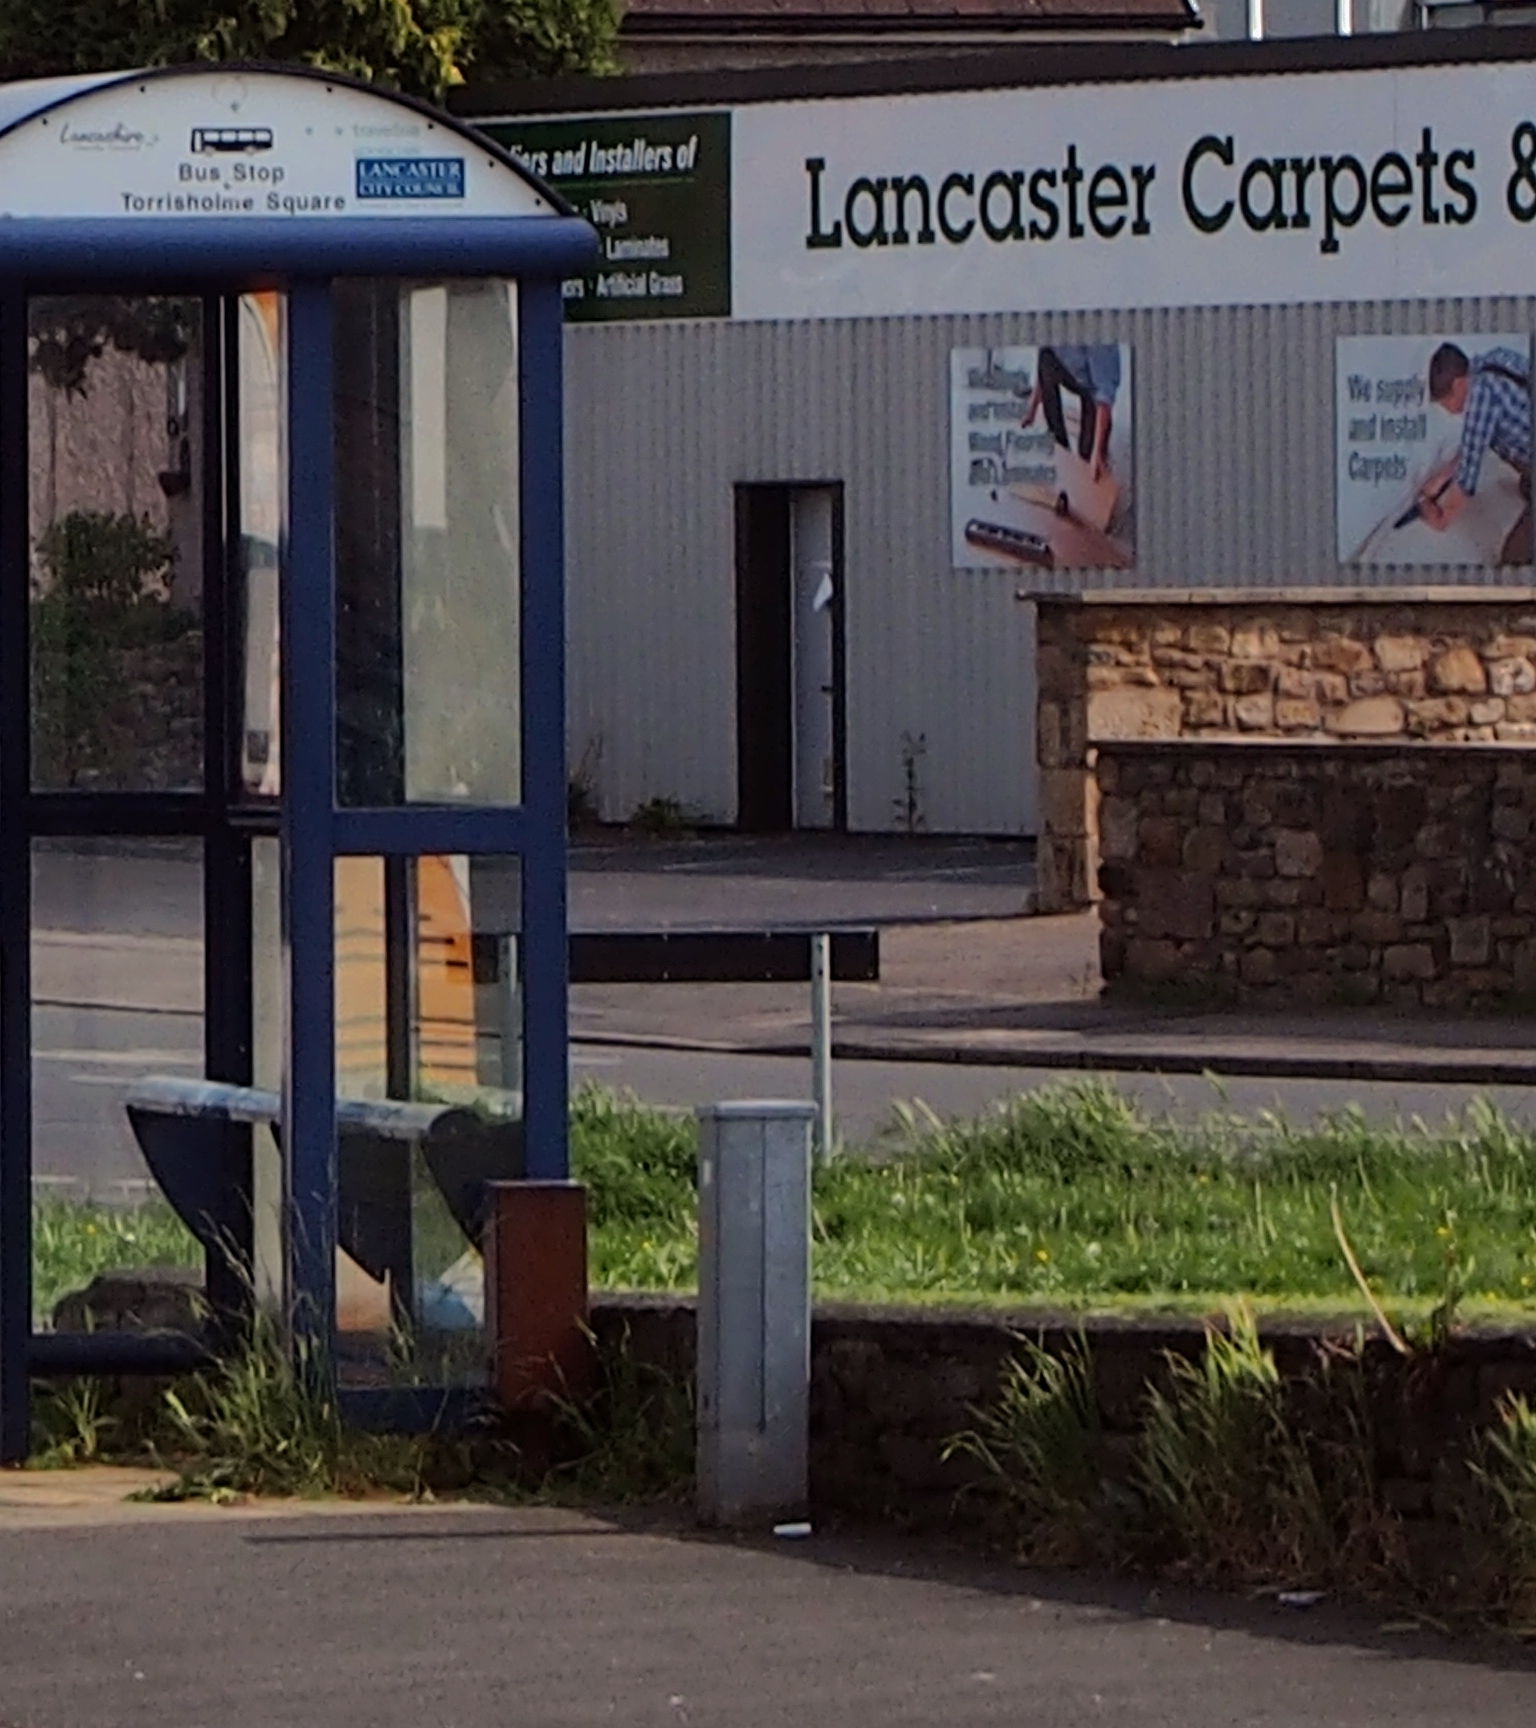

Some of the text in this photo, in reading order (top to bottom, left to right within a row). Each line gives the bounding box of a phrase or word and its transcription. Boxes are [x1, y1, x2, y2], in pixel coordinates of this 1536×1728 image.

[552, 140, 588, 176] and
[589, 136, 674, 173] Installers
[676, 134, 698, 171] of
[179, 162, 285, 185] Bus Stop
[359, 161, 462, 179] LANCASTER
[805, 144, 1156, 249] Lancaster
[1181, 126, 1478, 254] Carpets
[121, 192, 346, 215] Torrisholme Square
